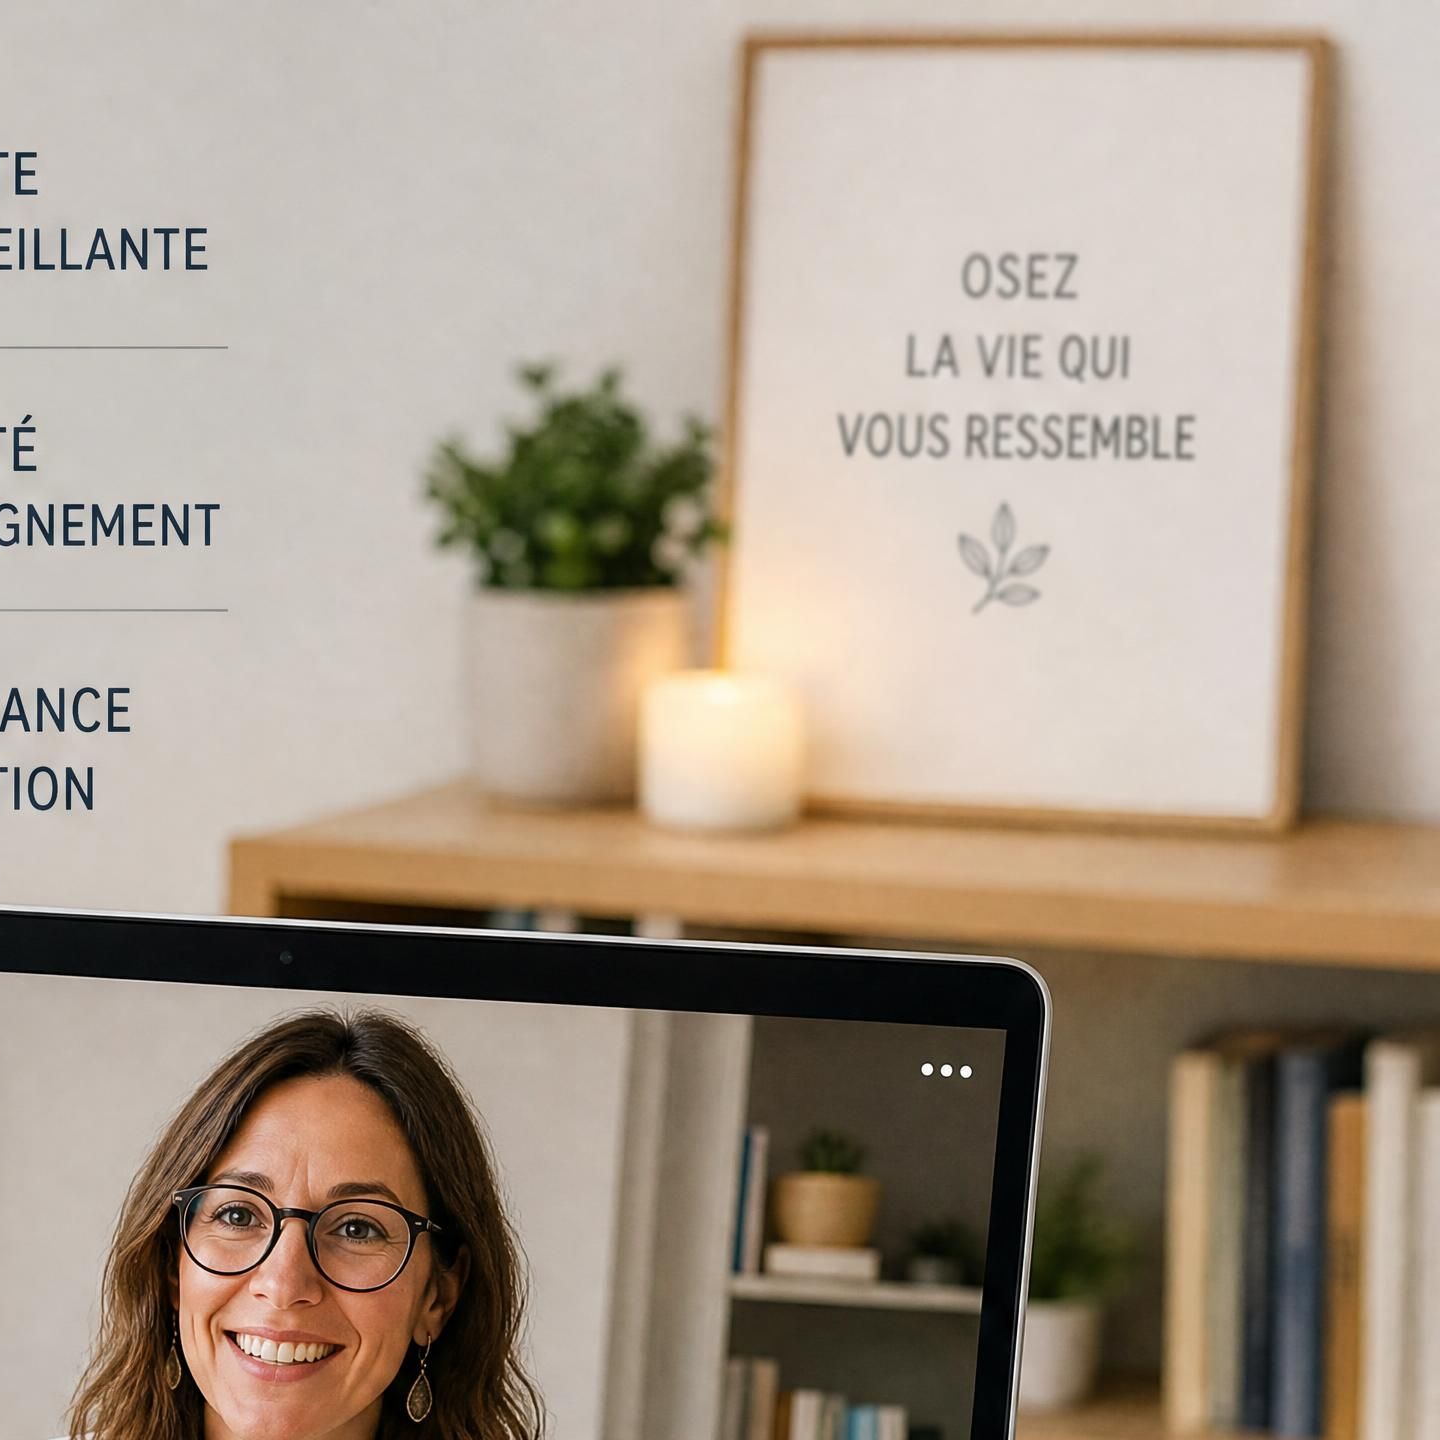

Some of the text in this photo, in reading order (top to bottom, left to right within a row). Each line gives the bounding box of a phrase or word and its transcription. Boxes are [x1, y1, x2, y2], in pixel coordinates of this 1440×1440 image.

[961, 252, 1079, 300] OSEZ
[905, 333, 1131, 383] LA VIE QUI
[837, 411, 1196, 461] VOUS RESSEMBLE
